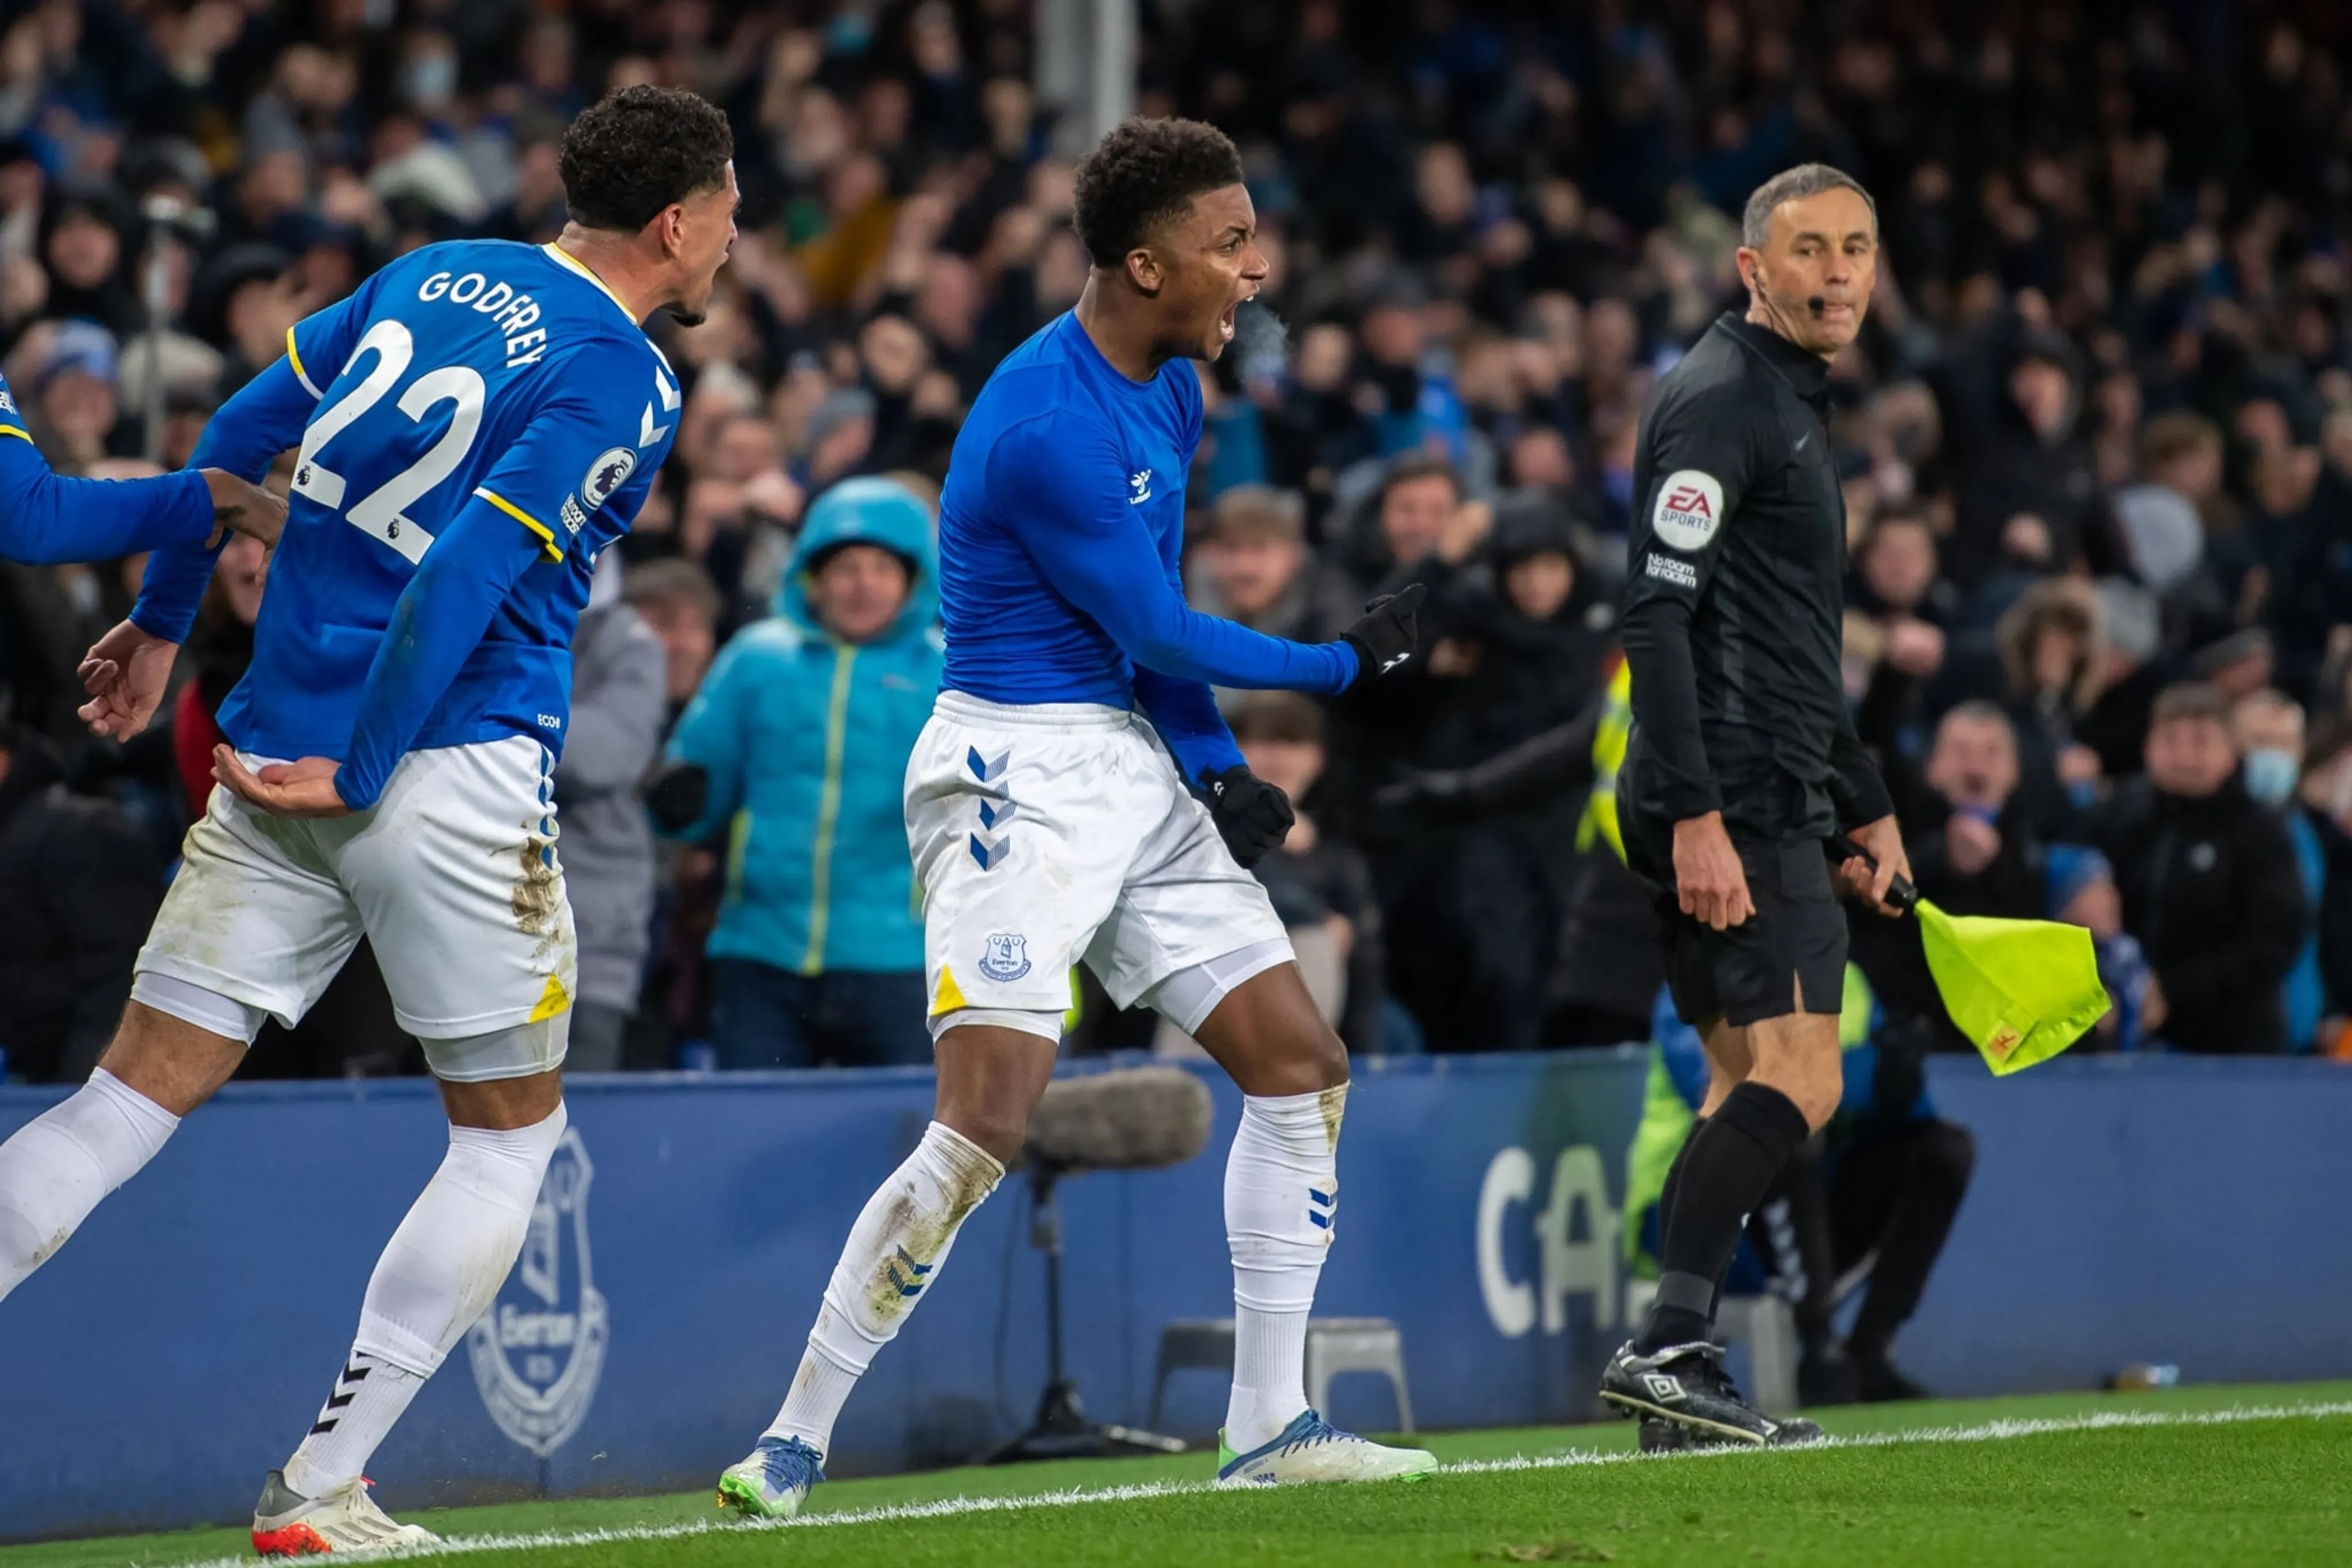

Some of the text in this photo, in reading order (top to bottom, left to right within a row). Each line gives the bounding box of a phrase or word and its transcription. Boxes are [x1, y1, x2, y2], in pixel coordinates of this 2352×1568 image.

[418, 271, 547, 368] GODFREY
[290, 320, 486, 565] 22
[1665, 485, 1711, 519] EA
[1660, 509, 1711, 532] SPORTS
[1648, 552, 1695, 576] No room
[1660, 568, 1697, 588] racism
